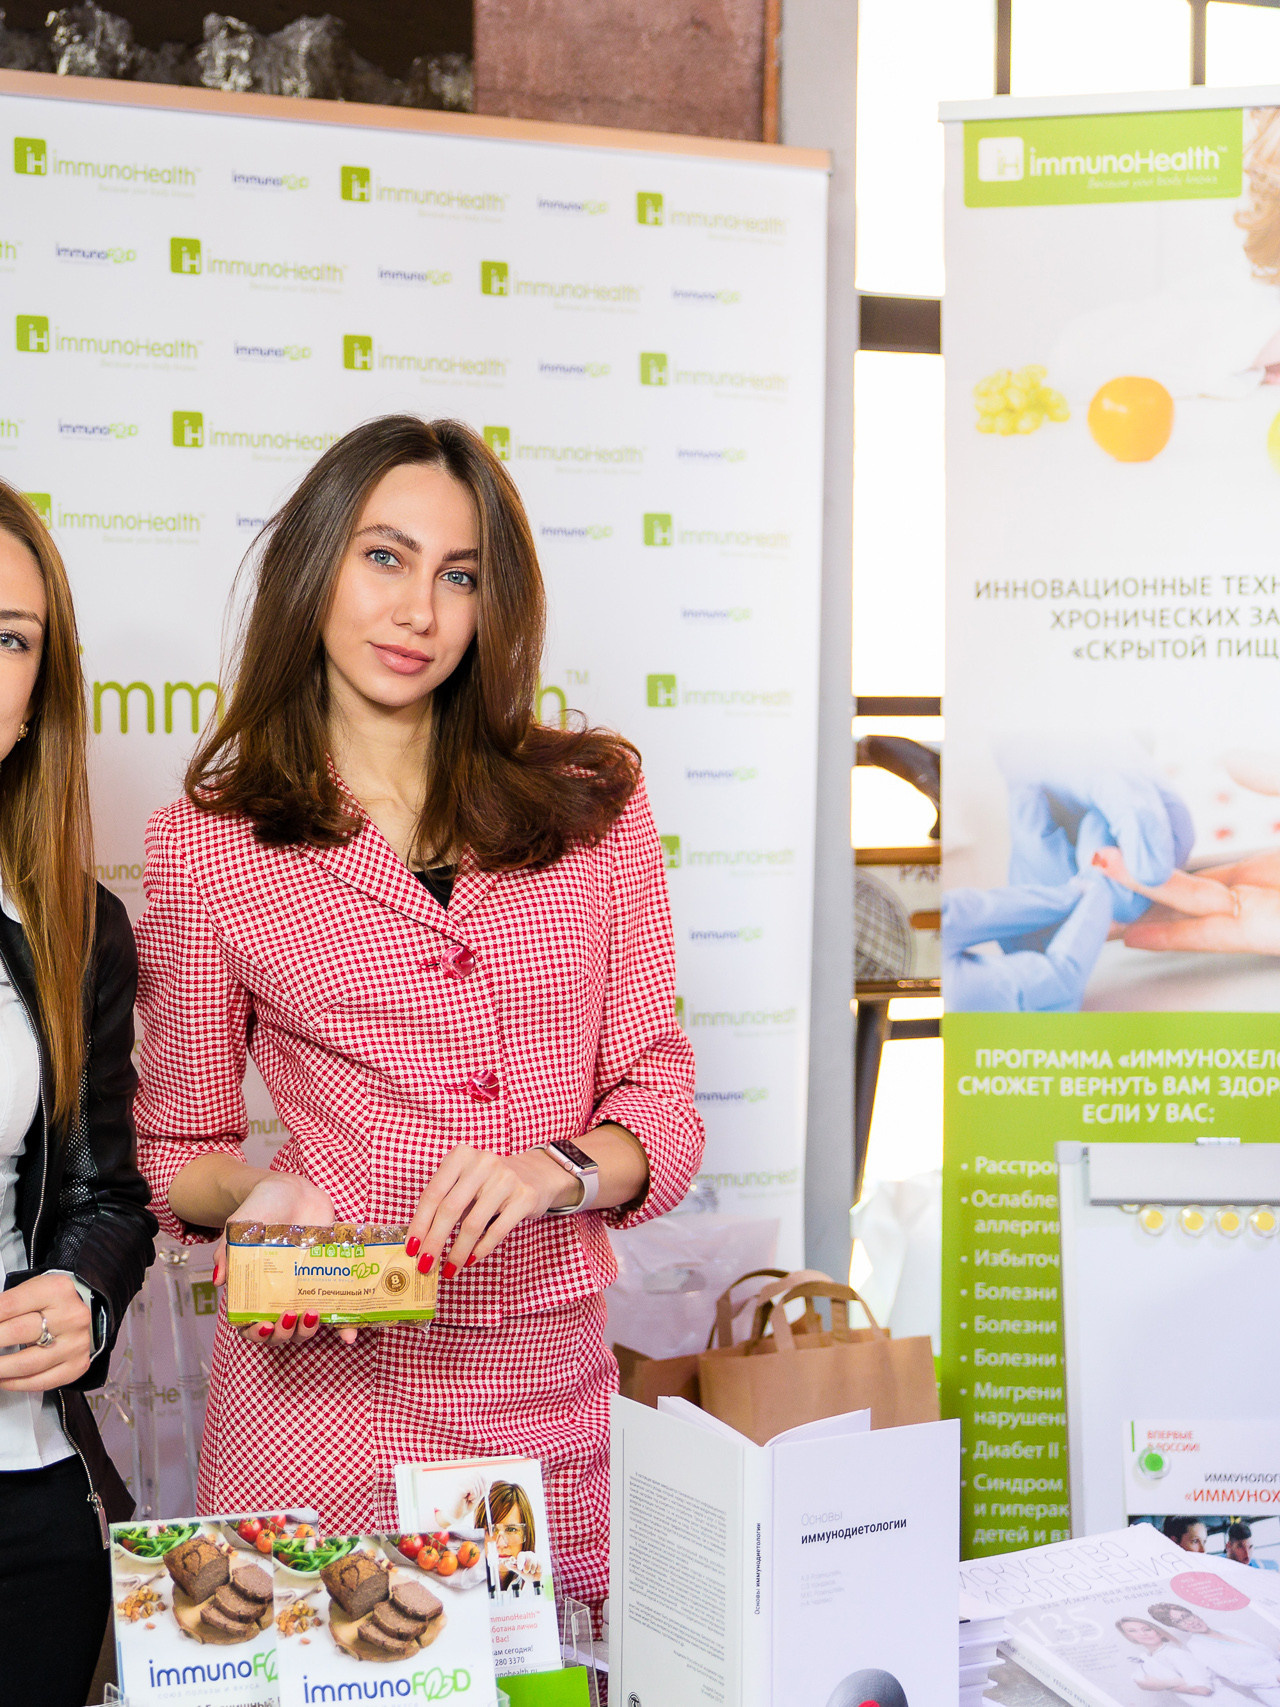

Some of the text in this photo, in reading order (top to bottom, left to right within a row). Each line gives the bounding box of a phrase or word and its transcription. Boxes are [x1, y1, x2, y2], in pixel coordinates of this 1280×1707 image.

[1030, 146, 1219, 176] immunoHealth
[975, 577, 1211, 601] ИННОВАЦИОННЫЕ
[1050, 607, 1240, 630] ХРОНИЧЕСКИХ
[1073, 635, 1206, 660] «СКРЫТОЙ
[976, 1049, 1113, 1070] ПРОГРАММА
[958, 1076, 1053, 1096] СМОЖЕТ
[1060, 1076, 1156, 1096] ВЕРНУТЬ
[1163, 1076, 1209, 1095] ВАМ
[1083, 1103, 1215, 1124] ЕСЛИ У ВАС:
[318, 1288, 361, 1296] Гречишный
[975, 1283, 1057, 1301] Болезни
[974, 1315, 1057, 1333] Болезни
[974, 1348, 1057, 1367] Болезни
[973, 1382, 1062, 1403] Мигрени
[973, 1441, 1044, 1460] Диабет
[973, 1473, 1063, 1496] Синдром
[801, 1511, 843, 1526] Основы
[974, 1503, 986, 1515] и
[801, 1519, 907, 1544] иммунодиетологии
[973, 1527, 1045, 1545] детей и
